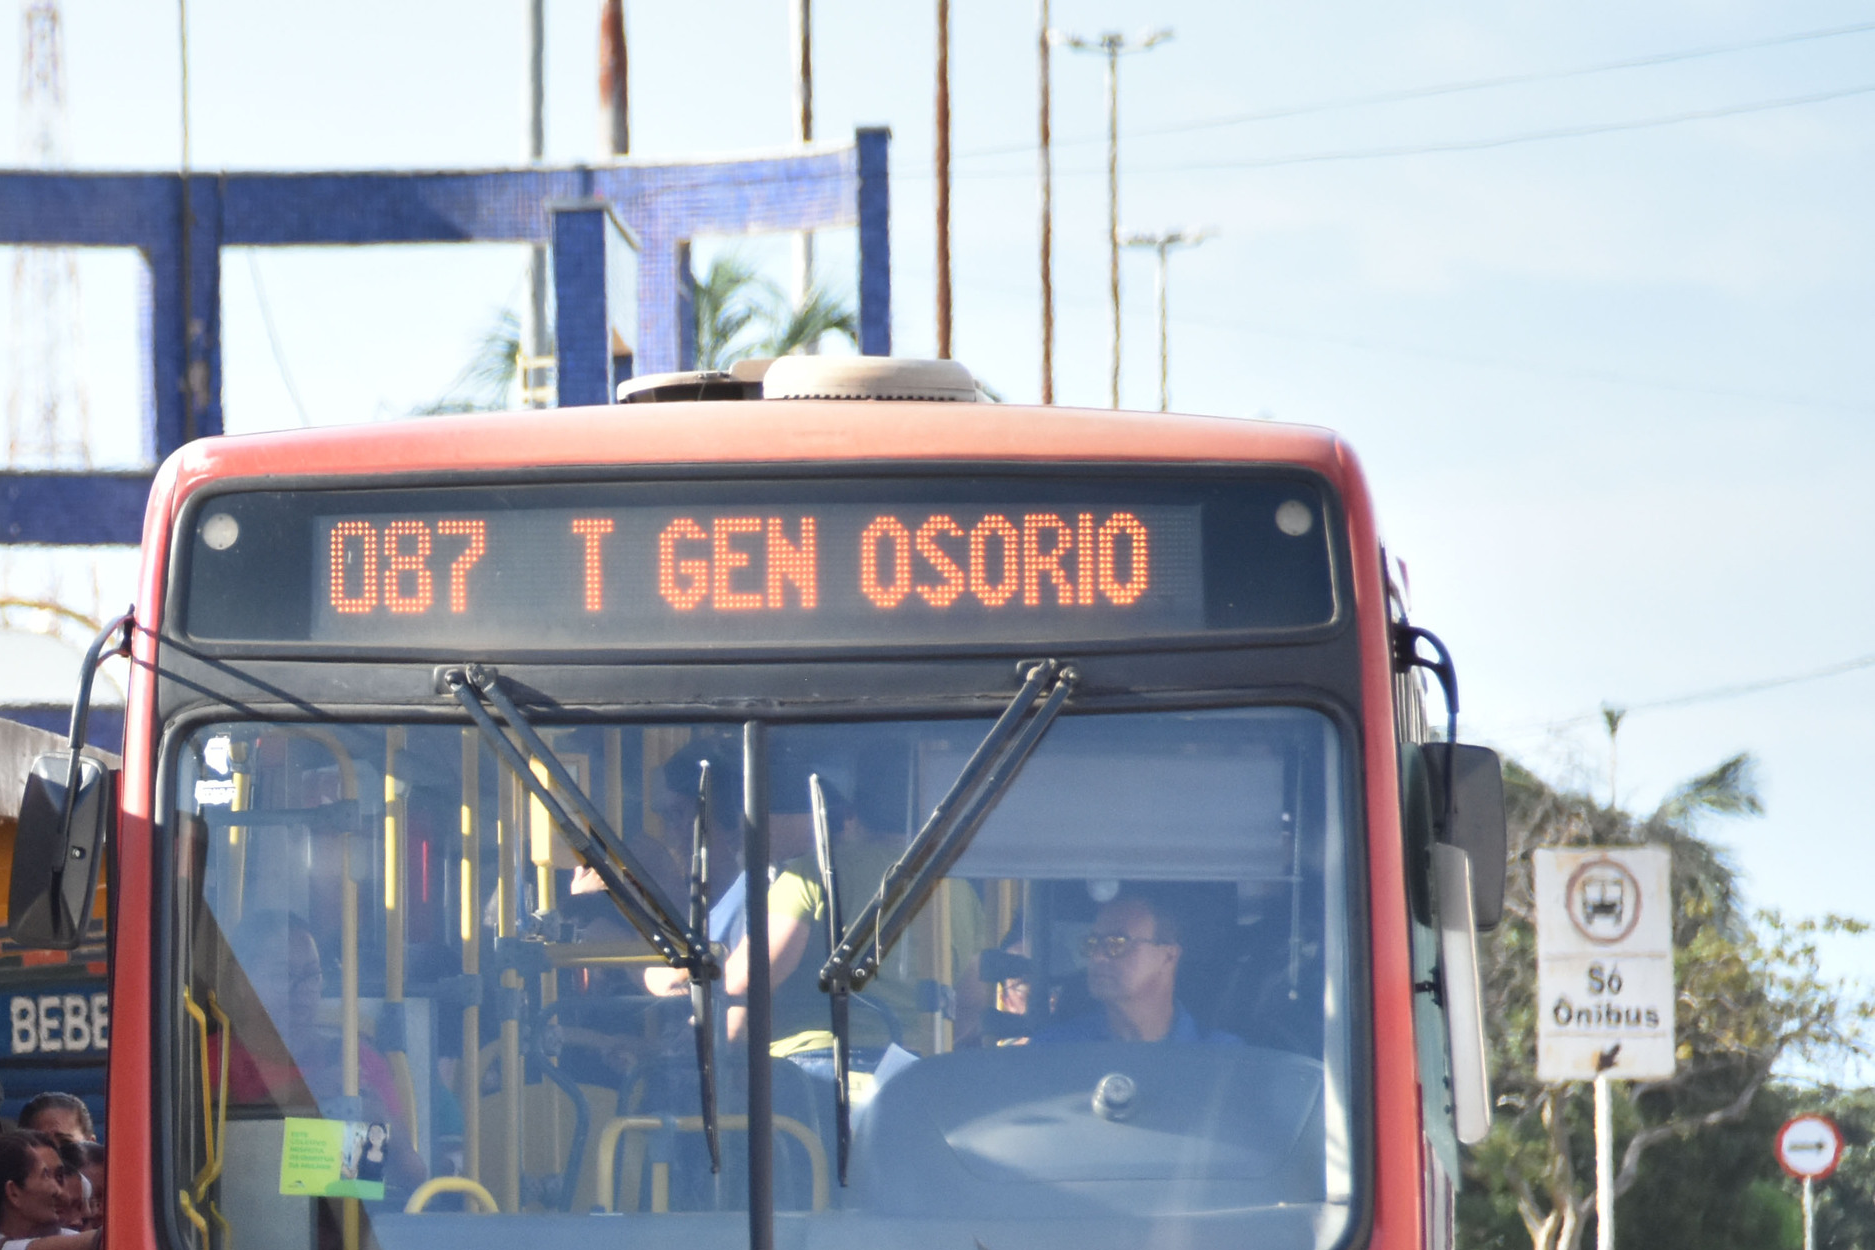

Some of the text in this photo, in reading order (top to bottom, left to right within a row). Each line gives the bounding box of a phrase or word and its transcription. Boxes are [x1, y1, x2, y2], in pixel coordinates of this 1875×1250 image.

[328, 512, 1149, 615] 087 T GEN OSORIO
[1588, 961, 1623, 995] Só
[1552, 996, 1661, 1029] Ônibus
